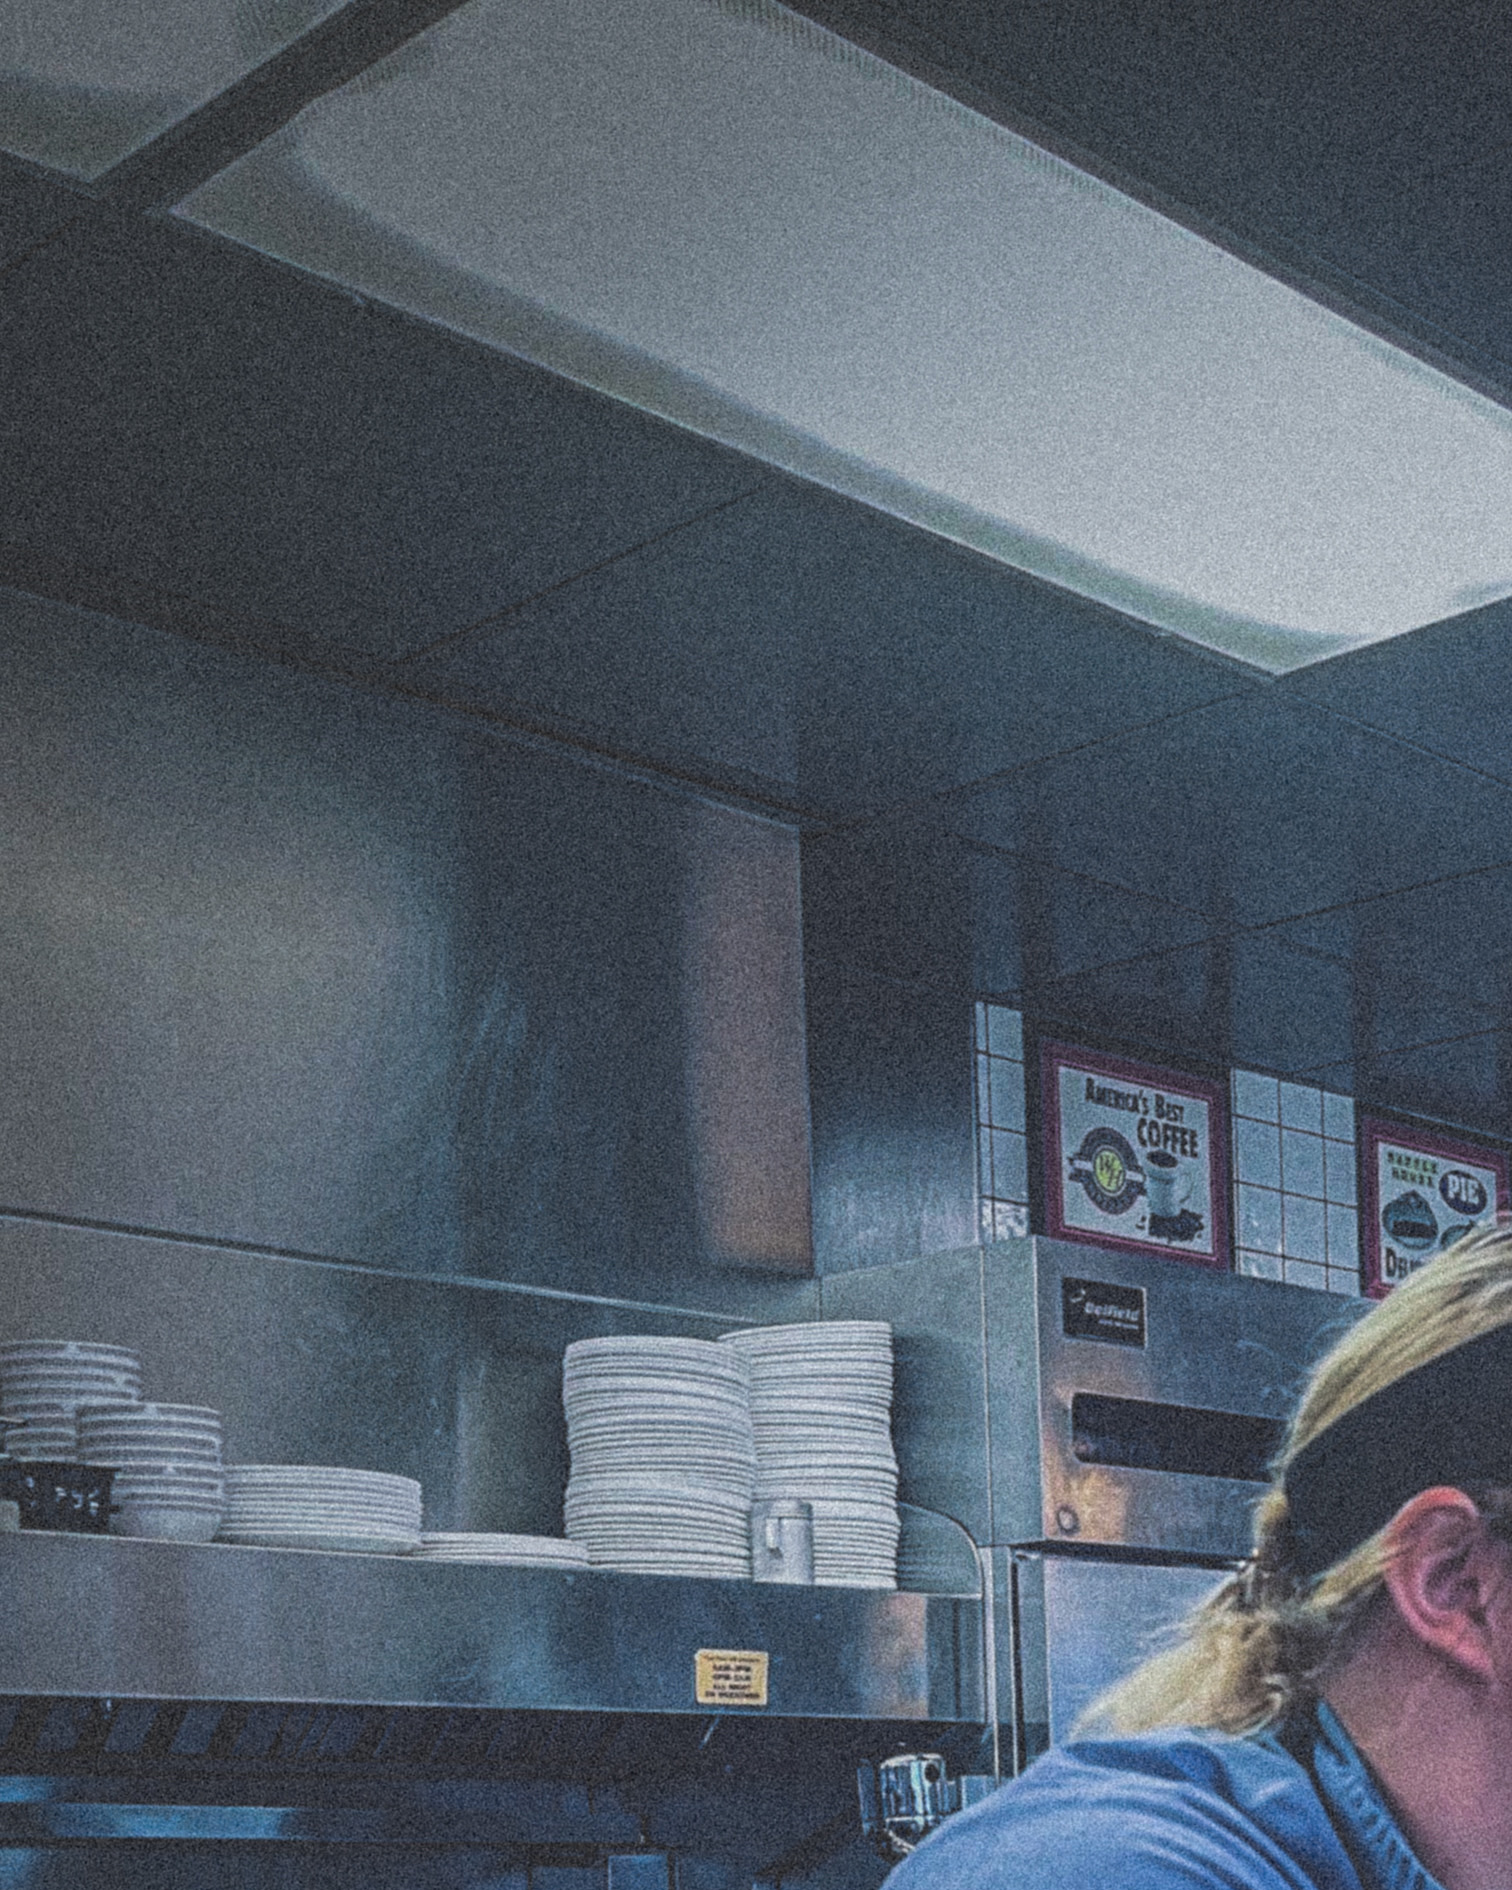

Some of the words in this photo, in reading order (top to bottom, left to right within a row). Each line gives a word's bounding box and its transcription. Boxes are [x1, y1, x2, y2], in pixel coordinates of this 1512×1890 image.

[1085, 1077, 1149, 1116] AMERICA'S
[1154, 1094, 1185, 1123] BEST
[1137, 1118, 1199, 1158] COFFEE
[1447, 1174, 1482, 1205] PIE
